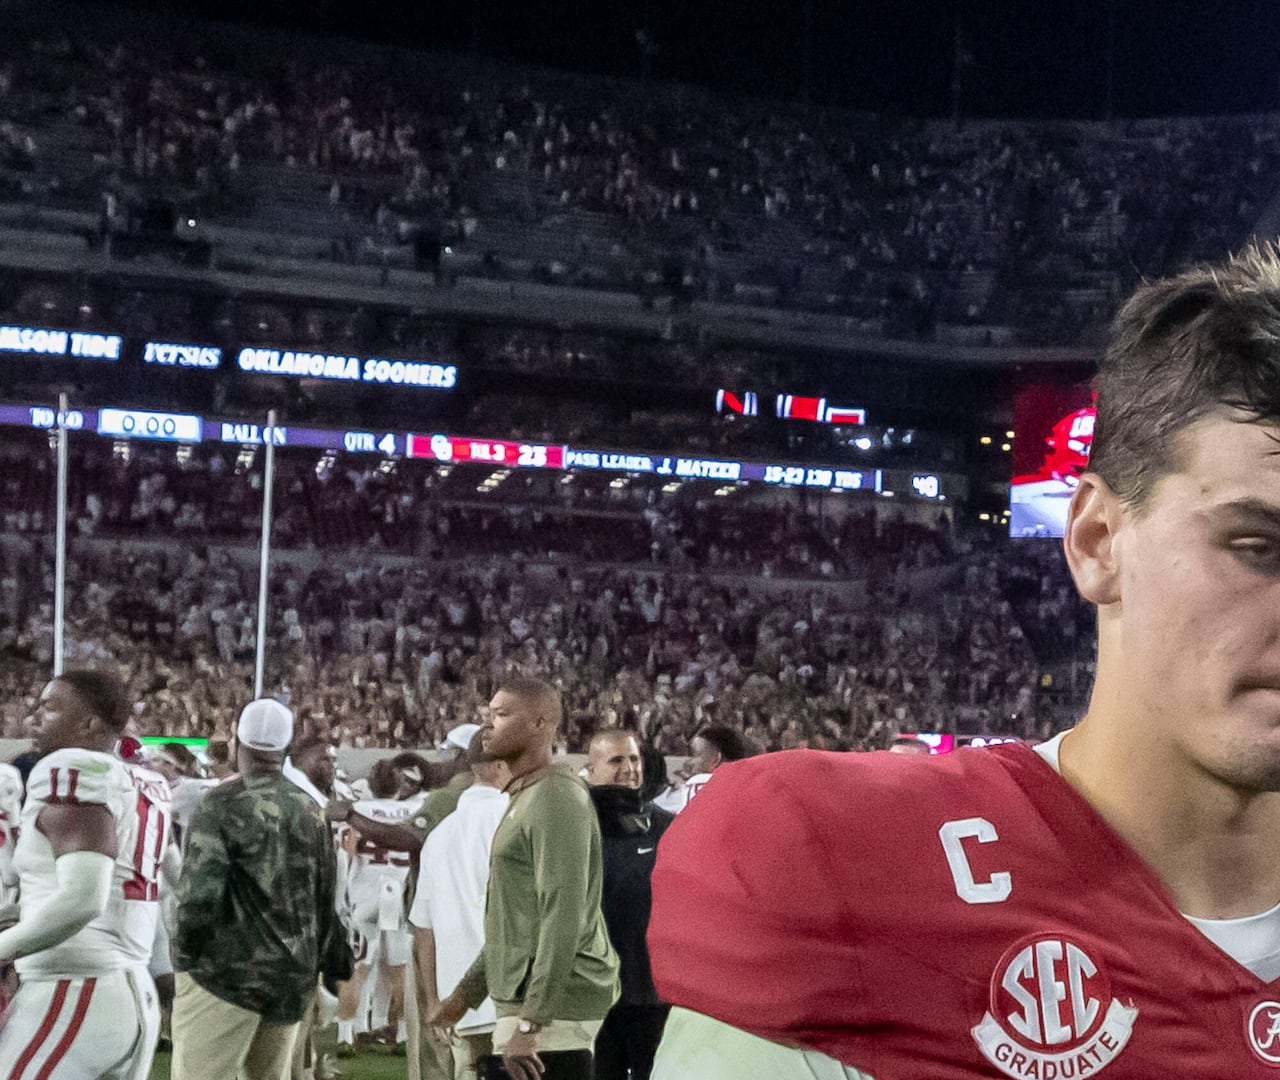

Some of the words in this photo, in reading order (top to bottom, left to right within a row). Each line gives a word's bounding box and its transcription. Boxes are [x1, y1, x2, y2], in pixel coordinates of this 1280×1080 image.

[70, 332, 122, 360] TIDE
[238, 348, 360, 380] OKLAHOMA
[363, 358, 458, 388] SOONERS
[221, 422, 261, 444] BALL
[344, 431, 376, 453] QTR
[378, 433, 396, 455] 4
[566, 451, 600, 468] PASS
[938, 817, 1012, 904] C
[1001, 940, 1101, 1045] SEC
